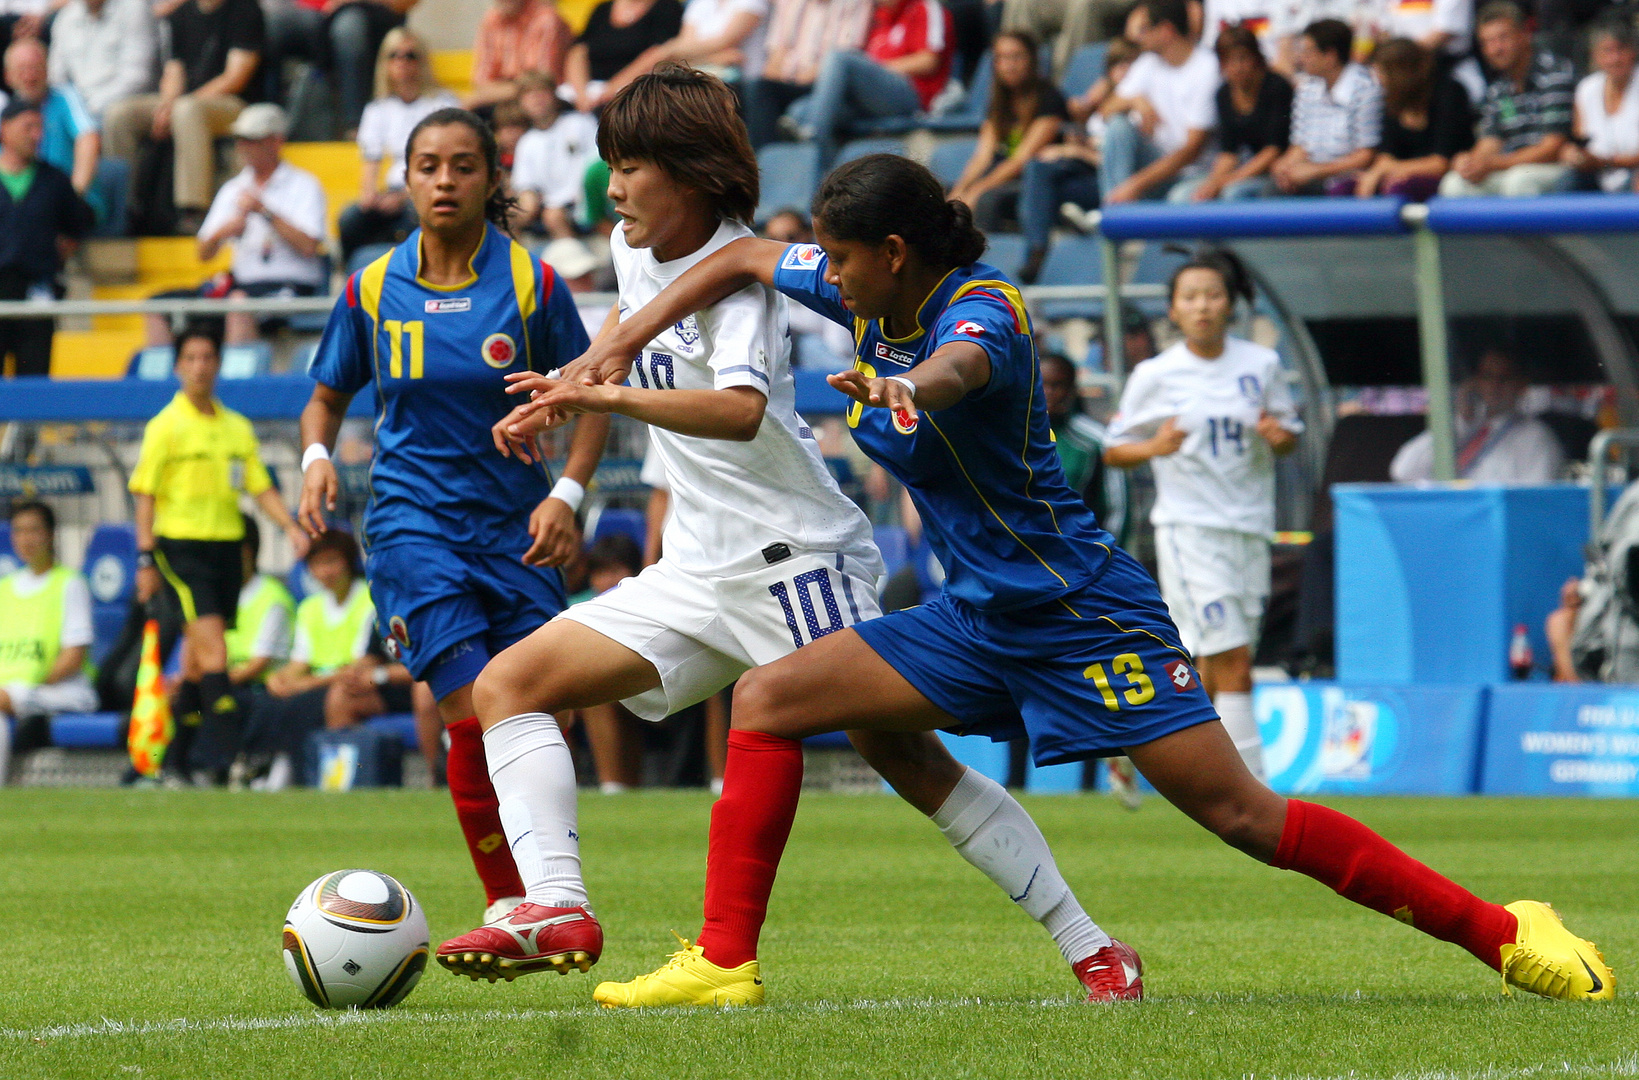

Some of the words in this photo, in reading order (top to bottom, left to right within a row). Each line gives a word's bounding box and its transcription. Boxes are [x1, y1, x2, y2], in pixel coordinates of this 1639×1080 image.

[383, 319, 425, 379] 11
[1208, 416, 1244, 457] 14
[768, 567, 845, 649] 10
[1083, 652, 1156, 712] 13
[1550, 759, 1638, 783] GERMANY
